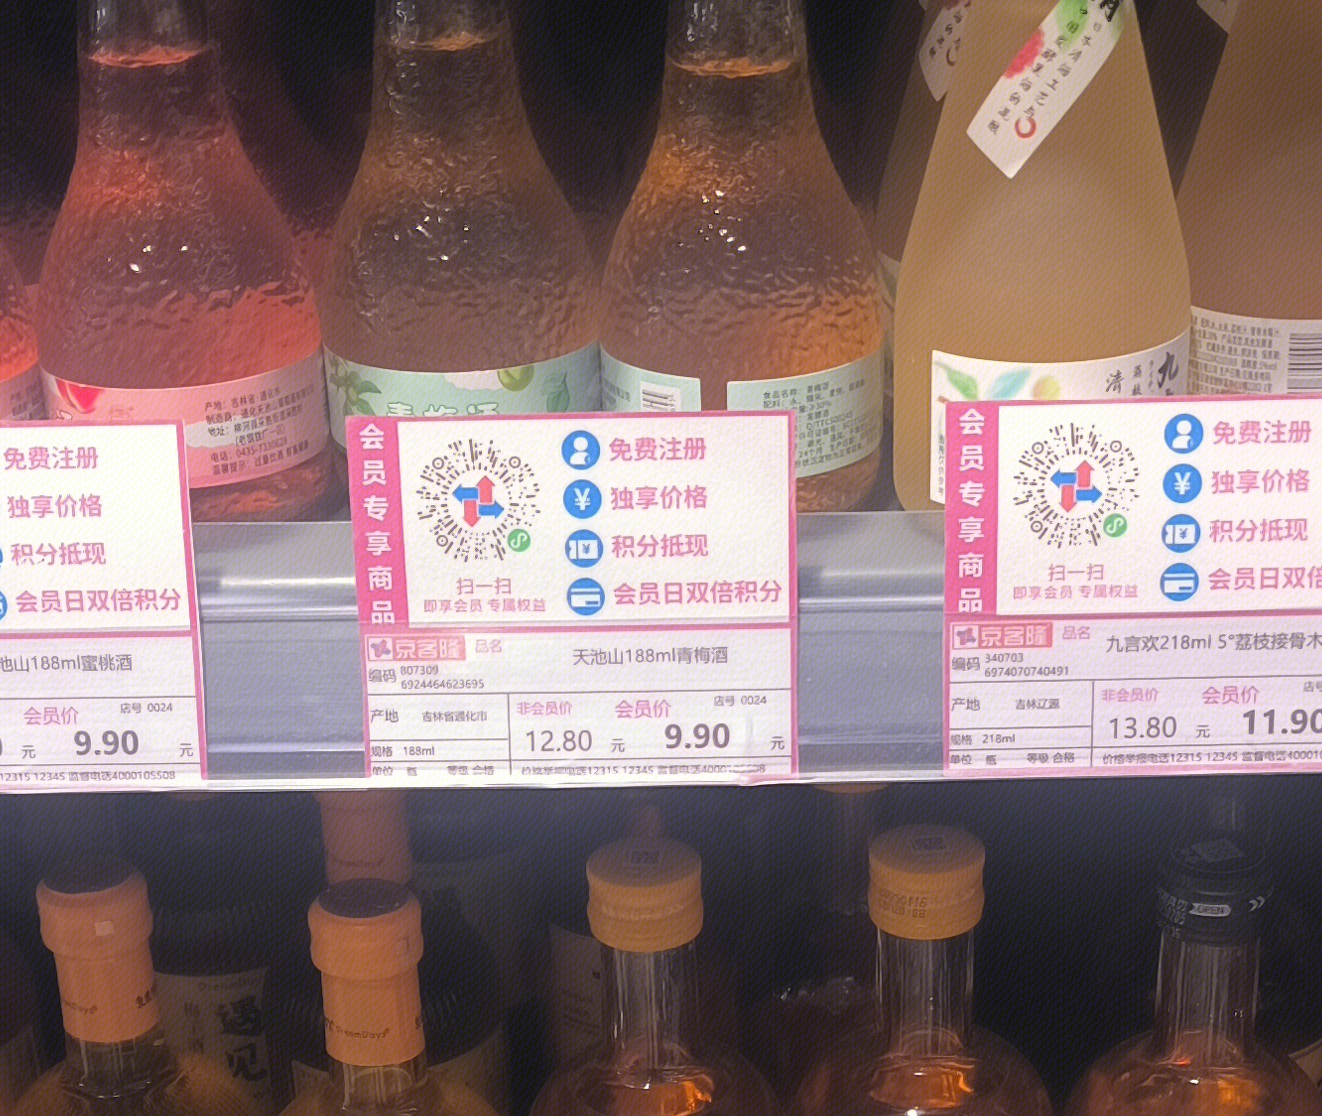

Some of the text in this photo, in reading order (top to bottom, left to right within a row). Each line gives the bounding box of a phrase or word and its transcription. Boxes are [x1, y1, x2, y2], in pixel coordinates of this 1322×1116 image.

[1212, 419, 1312, 444] 免费注册
[3, 447, 98, 471] 免费注册
[609, 437, 707, 461] 免费注册
[1211, 469, 1310, 493] 独享价格
[7, 494, 103, 519] 独享价格
[610, 485, 708, 509] 独享价格
[958, 408, 985, 613] 会员专享商品
[360, 423, 396, 624] 会员专享商品
[1209, 518, 1308, 543] 积分抵现
[11, 543, 107, 566] 积分抵现
[611, 534, 708, 557] 积分抵现
[15, 588, 181, 613] 会员日双倍积分
[613, 579, 782, 605] 会员日双倍积分
[572, 647, 729, 665] 天池山188ml青梅酒
[526, 723, 730, 751] 12.80 9.90
[1109, 716, 1177, 739] 13.80
[73, 730, 139, 755] 9.90
